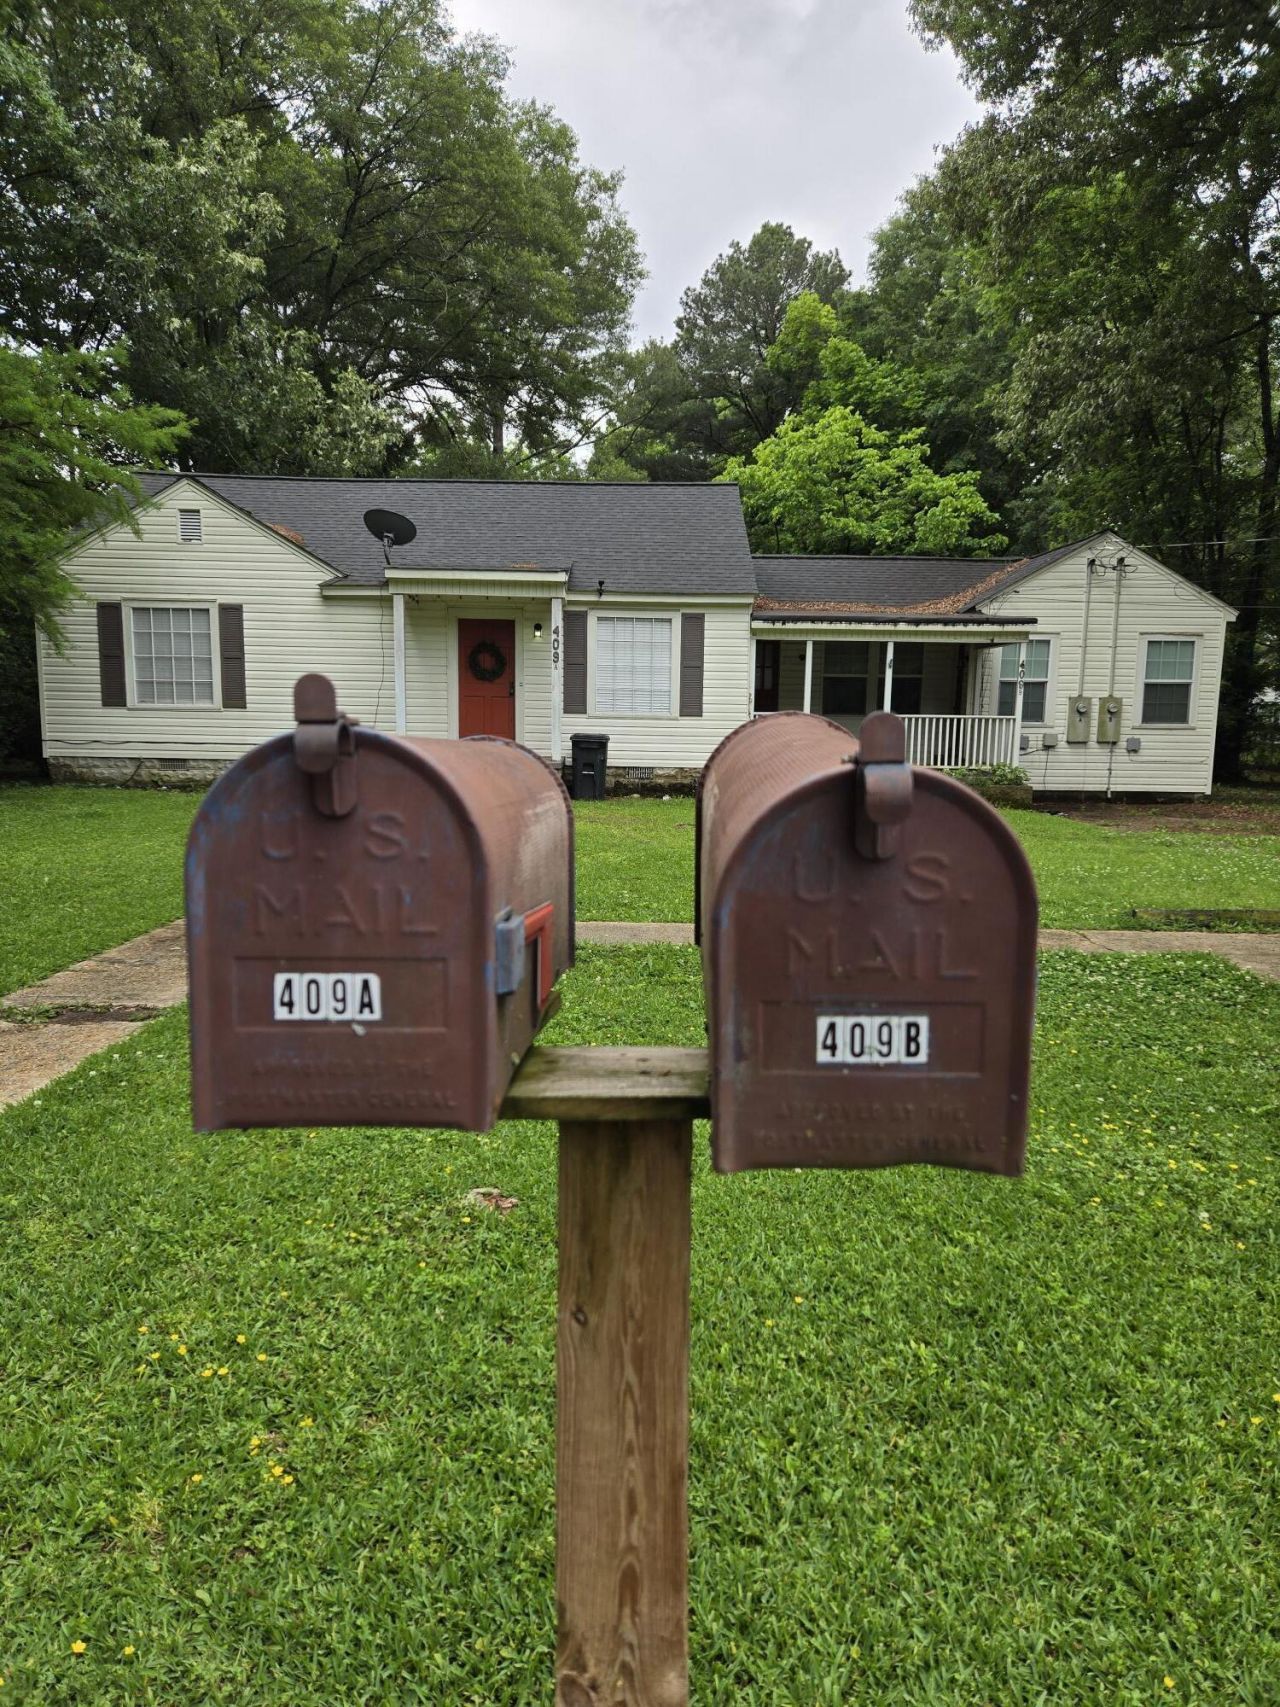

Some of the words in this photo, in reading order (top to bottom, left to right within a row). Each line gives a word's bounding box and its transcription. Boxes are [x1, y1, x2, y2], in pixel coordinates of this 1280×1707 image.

[253, 882, 440, 938] MAIL
[788, 927, 980, 982] MAIL
[279, 978, 375, 1015] 409A
[821, 1021, 921, 1058] 409B
